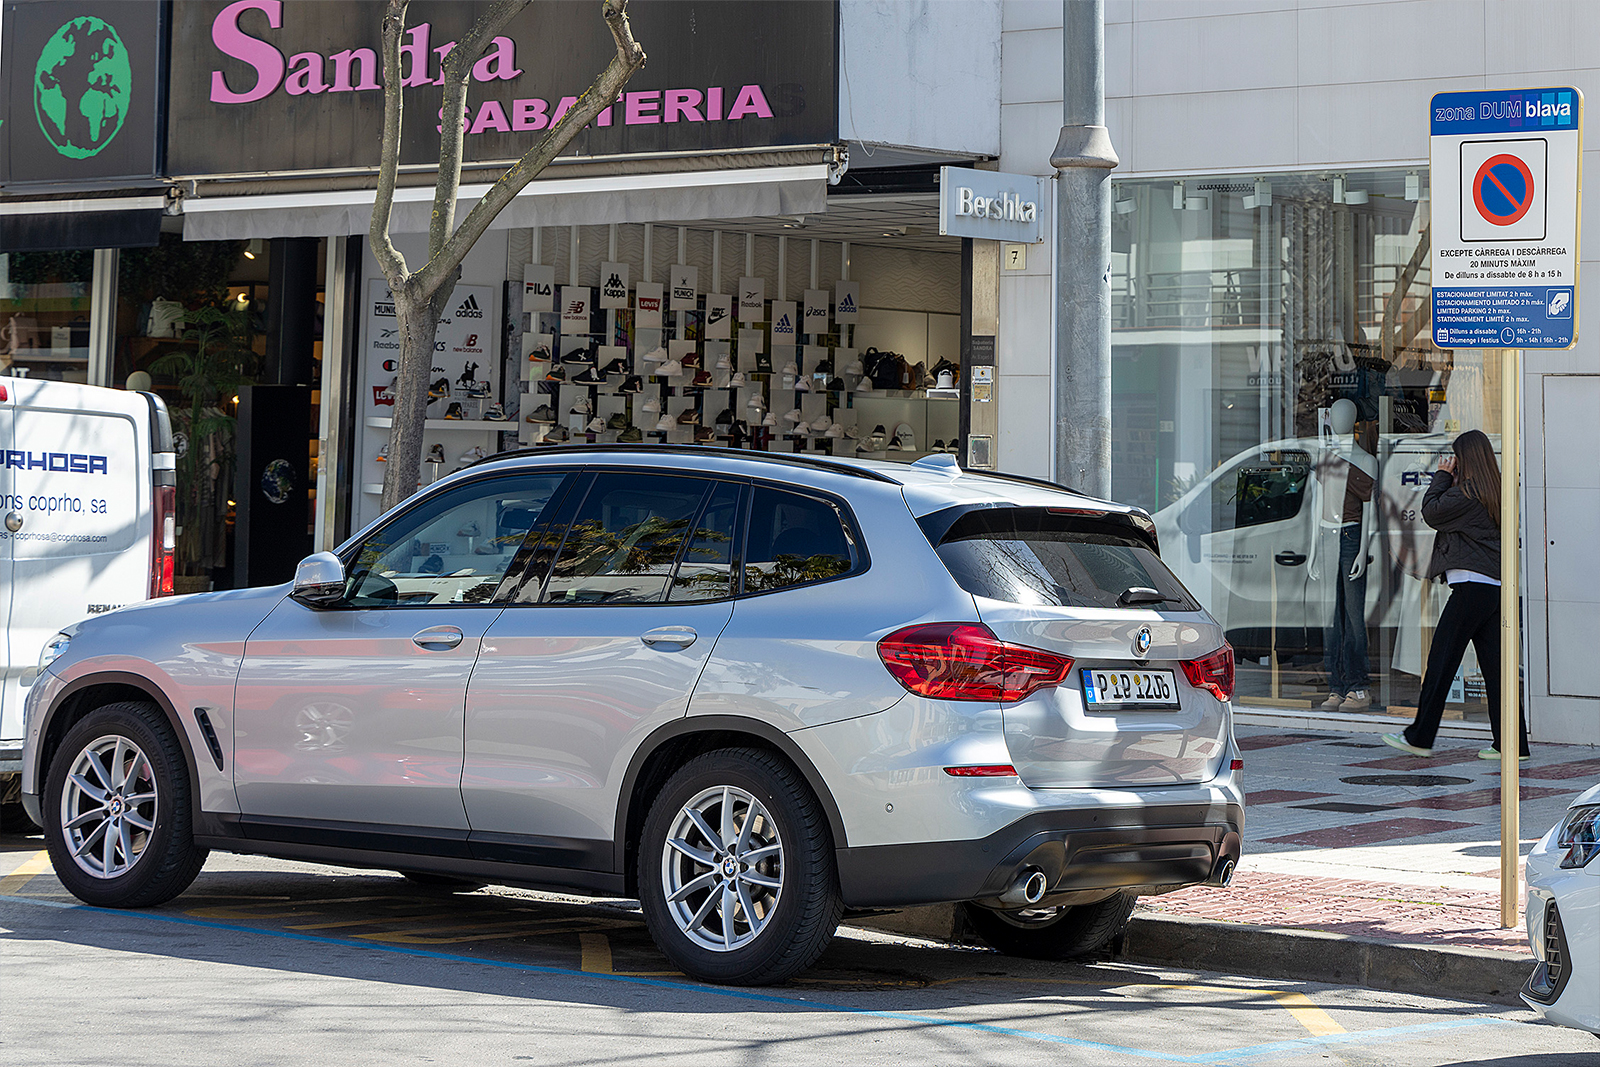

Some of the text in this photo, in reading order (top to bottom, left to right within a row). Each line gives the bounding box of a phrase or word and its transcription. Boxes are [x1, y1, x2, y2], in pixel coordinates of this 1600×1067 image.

[1435, 100, 1571, 122] zona DUM blava
[956, 187, 1037, 222] Bershka
[1475, 247, 1510, 257] CÀRREGA
[1517, 246, 1566, 256] DESCÀRREGA
[1012, 250, 1018, 264] 7
[1510, 258, 1535, 267] MÀXIM
[526, 282, 552, 296] FILA
[604, 288, 626, 298] Kappa
[674, 288, 694, 298] MUNICH
[740, 300, 762, 308] Reebok
[375, 305, 397, 314] MUNIC
[456, 308, 482, 318] adidas
[374, 341, 400, 350] Reebo
[376, 390, 396, 400] Lev
[28, 492, 85, 516] coprho,
[91, 498, 107, 514] sa
[15, 532, 107, 542] coprhosa@coprhosa.com
[87, 604, 125, 614] RENA
